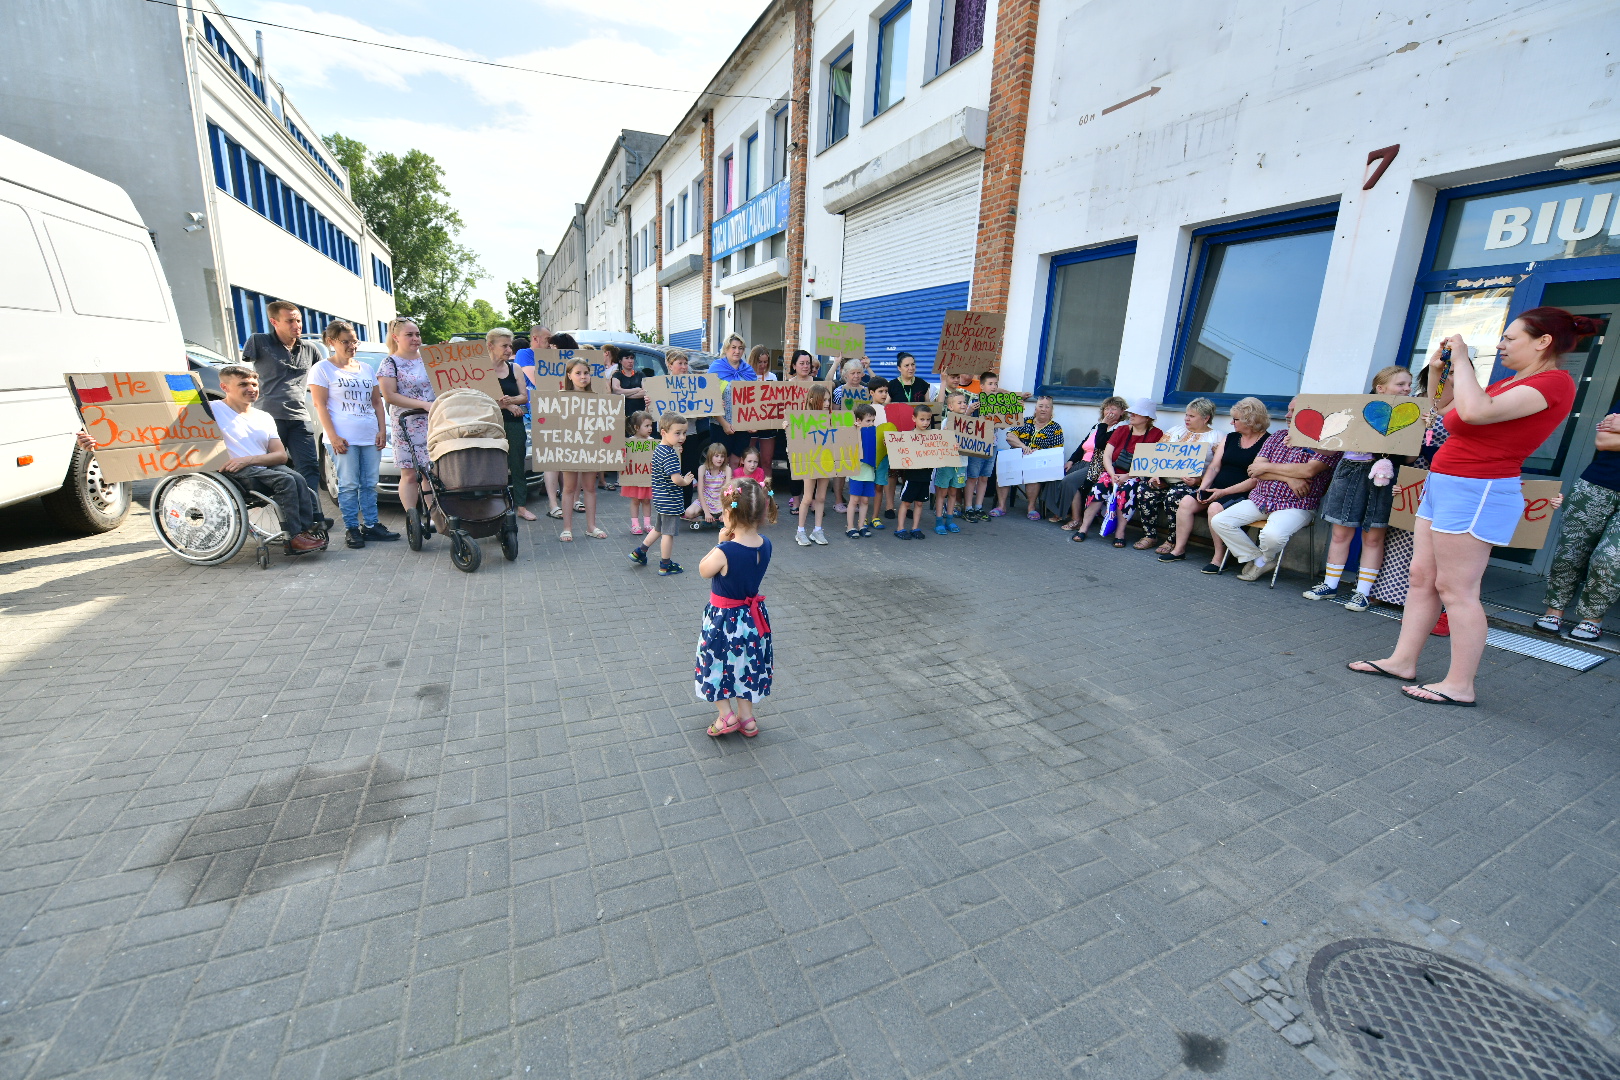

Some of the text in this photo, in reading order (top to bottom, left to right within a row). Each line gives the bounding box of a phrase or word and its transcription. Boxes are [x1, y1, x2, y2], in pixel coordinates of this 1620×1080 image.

[1362, 143, 1400, 190] 7
[1483, 192, 1620, 250] BIU
[113, 372, 151, 398] Не
[733, 385, 756, 405] NIE
[671, 390, 697, 402] ТУТ
[537, 395, 622, 420] NAJPIERW
[656, 398, 714, 416] РОБОТУ
[80, 405, 220, 451] Закривай
[577, 416, 616, 431] IKAR
[539, 429, 595, 445] TERAZ
[808, 428, 838, 446] ТУТ
